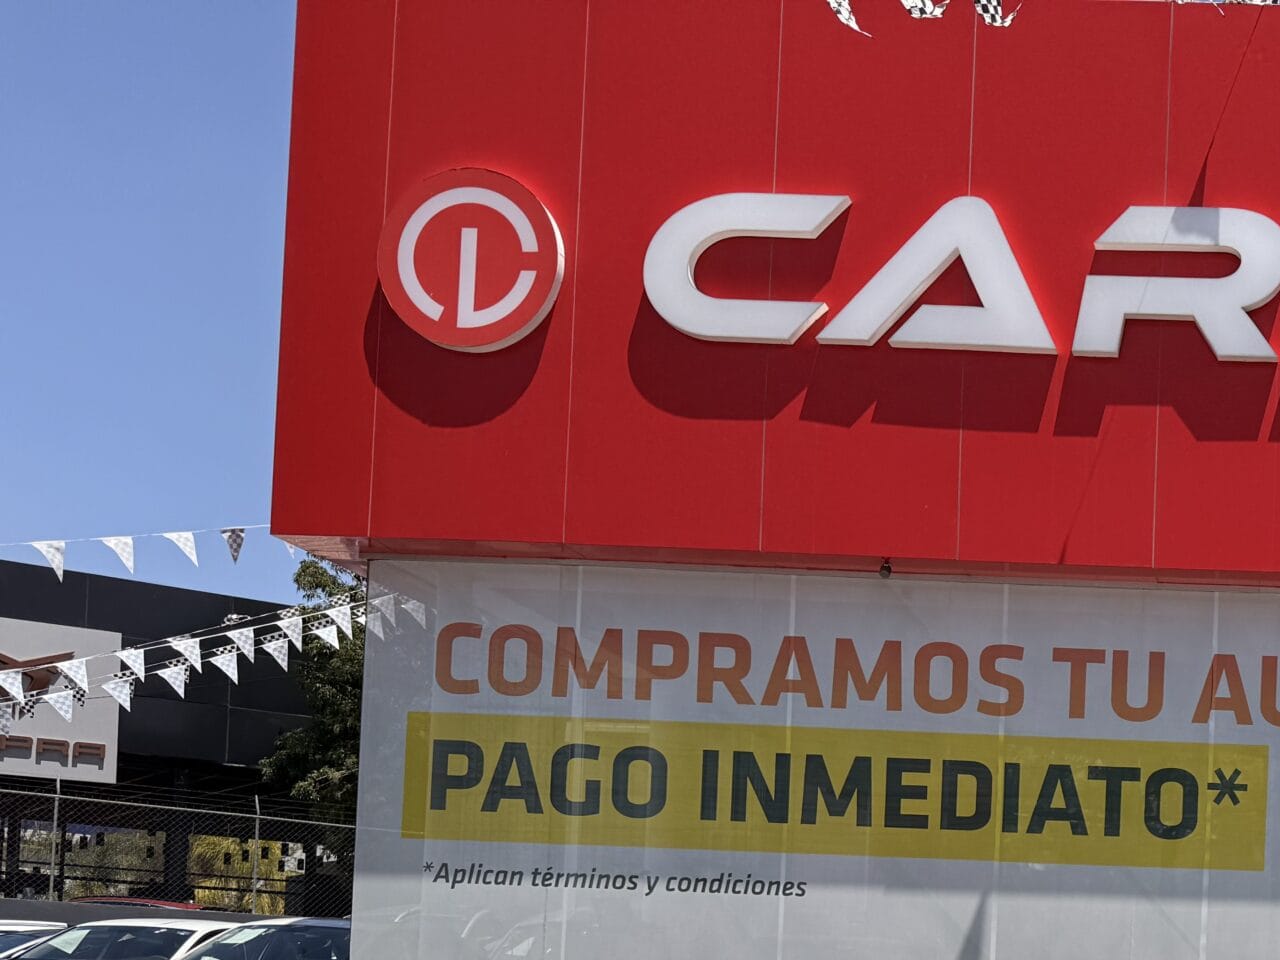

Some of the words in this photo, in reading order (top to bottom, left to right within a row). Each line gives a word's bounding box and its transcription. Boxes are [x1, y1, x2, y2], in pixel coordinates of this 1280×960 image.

[434, 621, 1025, 717] COMPRAMOS
[1051, 646, 1166, 723] TU
[429, 738, 668, 819] PAGO
[531, 867, 639, 892] términos
[644, 875, 660, 896] y
[665, 871, 808, 898] condiciones
